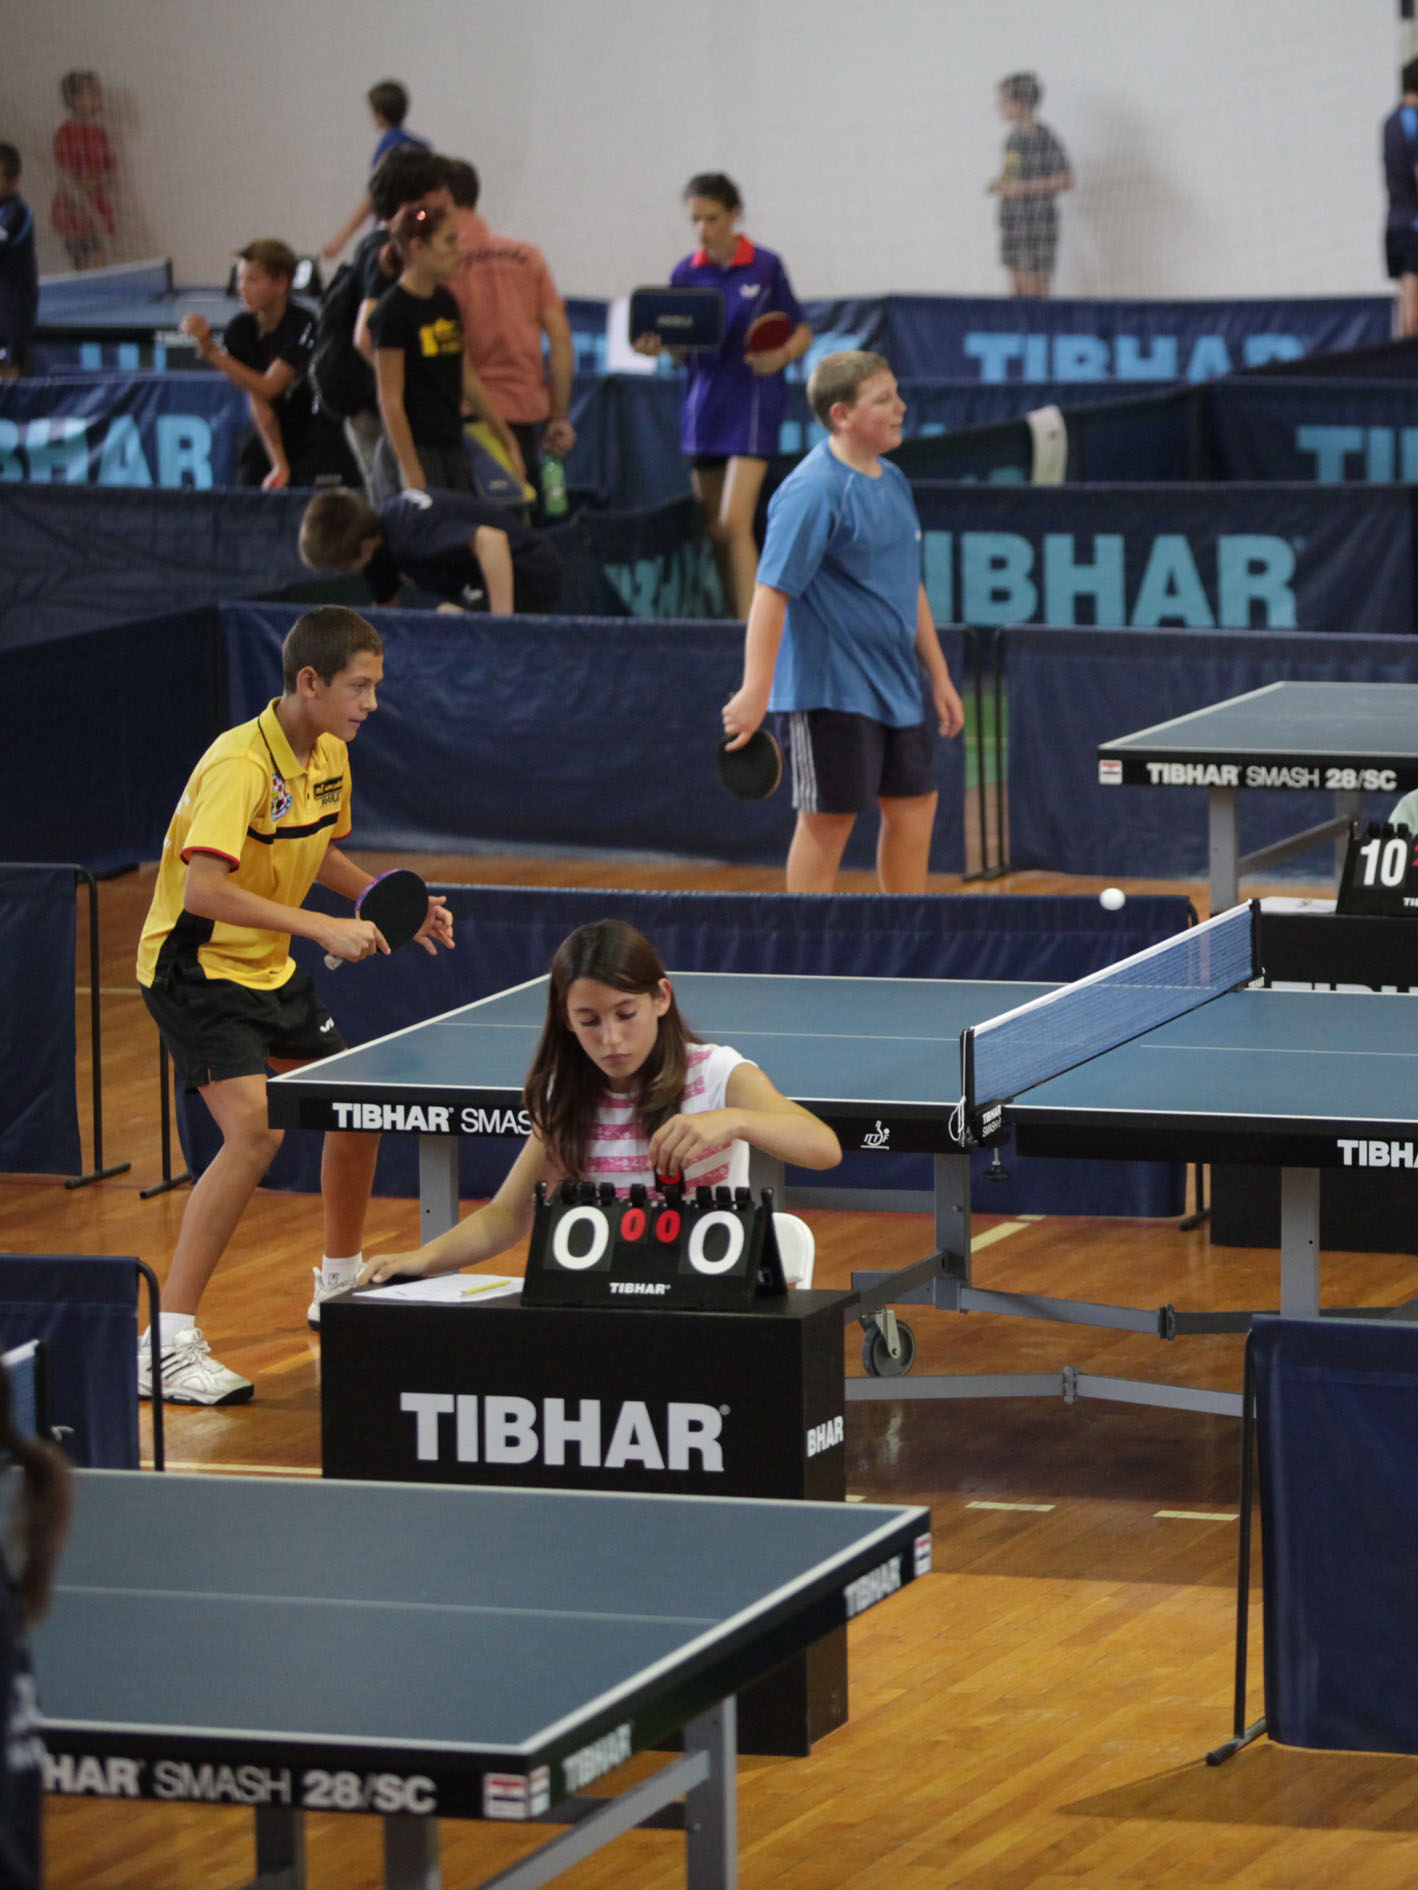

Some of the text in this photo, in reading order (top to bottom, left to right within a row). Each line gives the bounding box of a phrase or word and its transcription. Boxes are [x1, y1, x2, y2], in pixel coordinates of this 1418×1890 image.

[924, 531, 1298, 628] IBHAR
[1146, 762, 1397, 791] TIBHAR SMASH 28/SC
[1360, 838, 1407, 887] 10
[332, 1102, 533, 1135] TIBHAR SMAS
[553, 1205, 745, 1275] 0 0 0 0
[610, 1282, 667, 1295] TIBHAR
[400, 1392, 725, 1472] TIBHAR
[807, 1415, 844, 1457] BHAR
[844, 1555, 901, 1618] TIBHAR
[41, 1753, 437, 1814] HAR SMASH 28/SC
